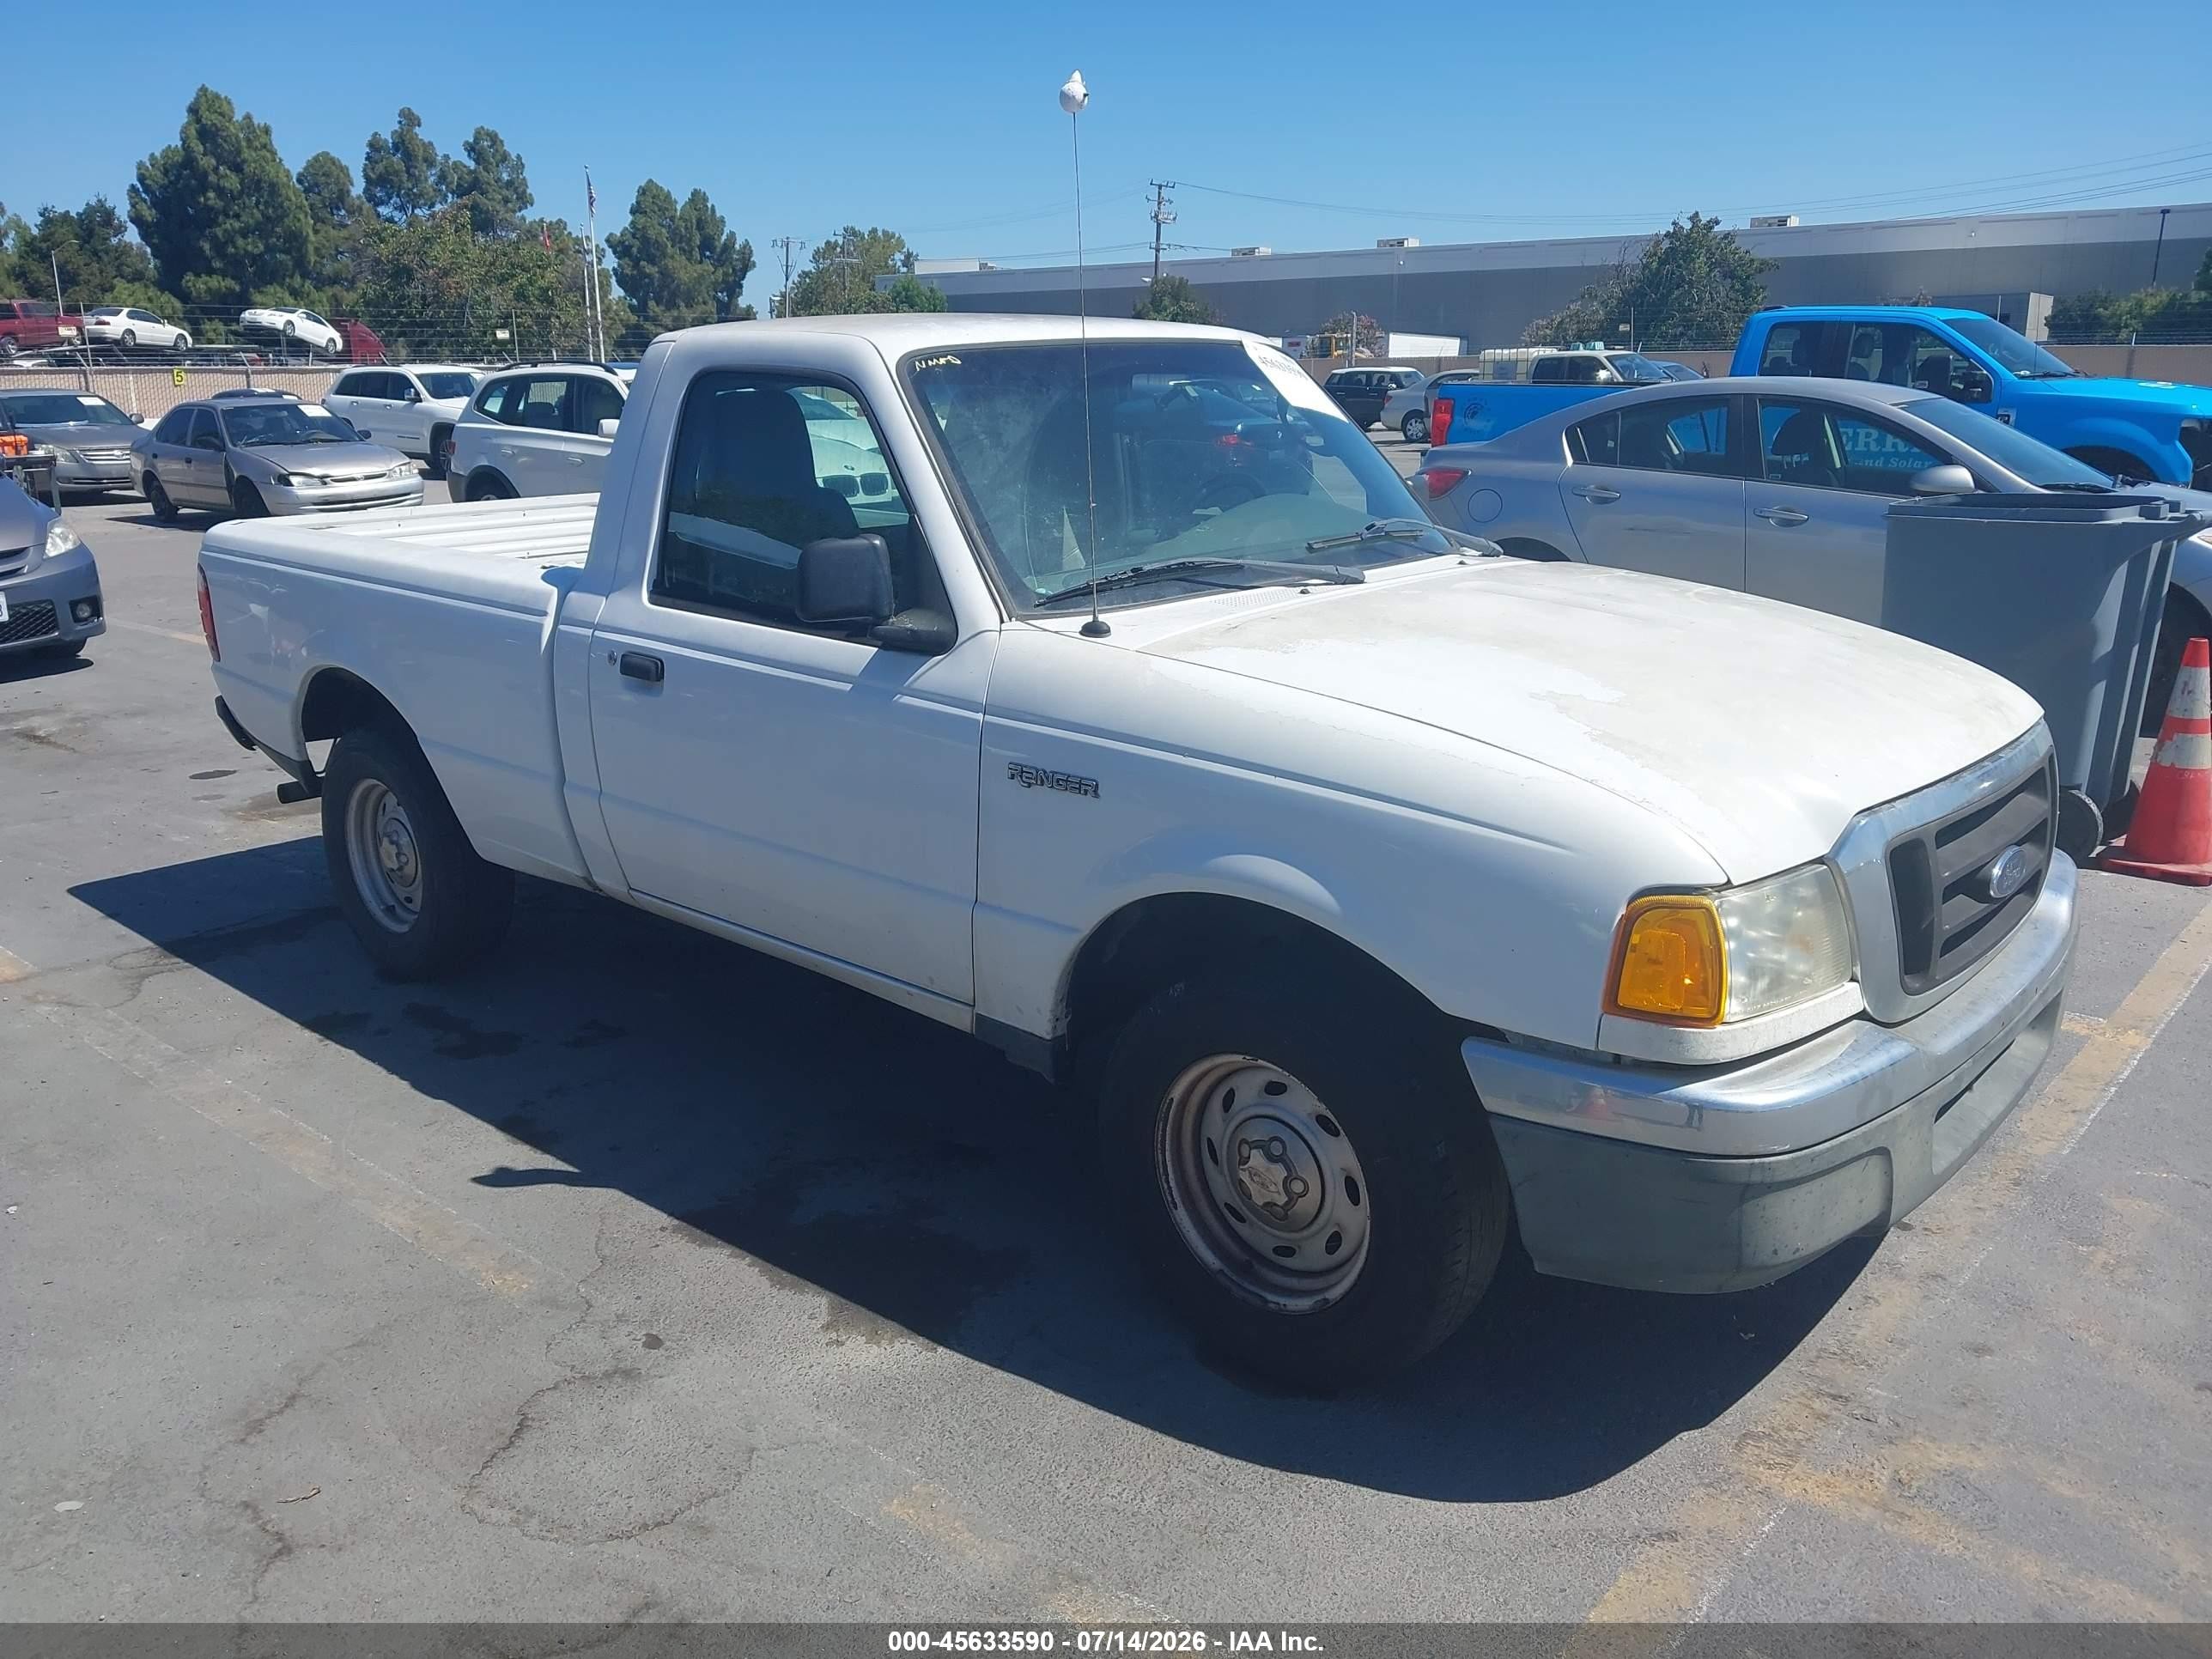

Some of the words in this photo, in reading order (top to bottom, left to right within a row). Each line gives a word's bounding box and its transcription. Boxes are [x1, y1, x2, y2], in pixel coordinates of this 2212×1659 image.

[176, 371, 184, 383] 5
[1889, 457, 1932, 468] Solar
[1007, 762, 1100, 799] RANGER
